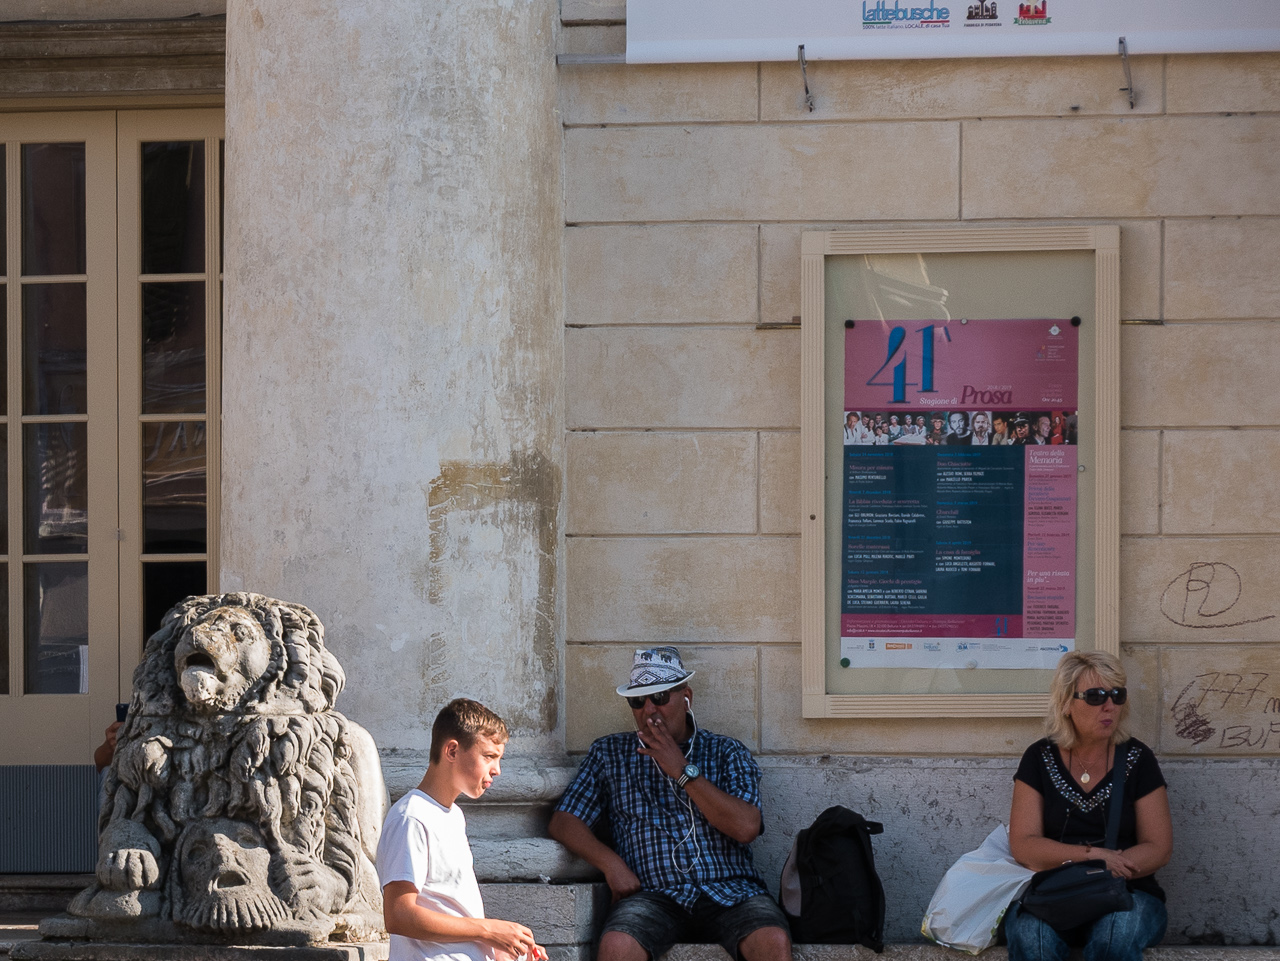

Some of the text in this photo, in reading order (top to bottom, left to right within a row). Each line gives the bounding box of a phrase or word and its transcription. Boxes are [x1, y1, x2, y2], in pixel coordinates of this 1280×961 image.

[862, 0, 950, 21] lattebusche
[919, 385, 1013, 407] Stagione di Prosa
[1029, 456, 1063, 464] Memoria
